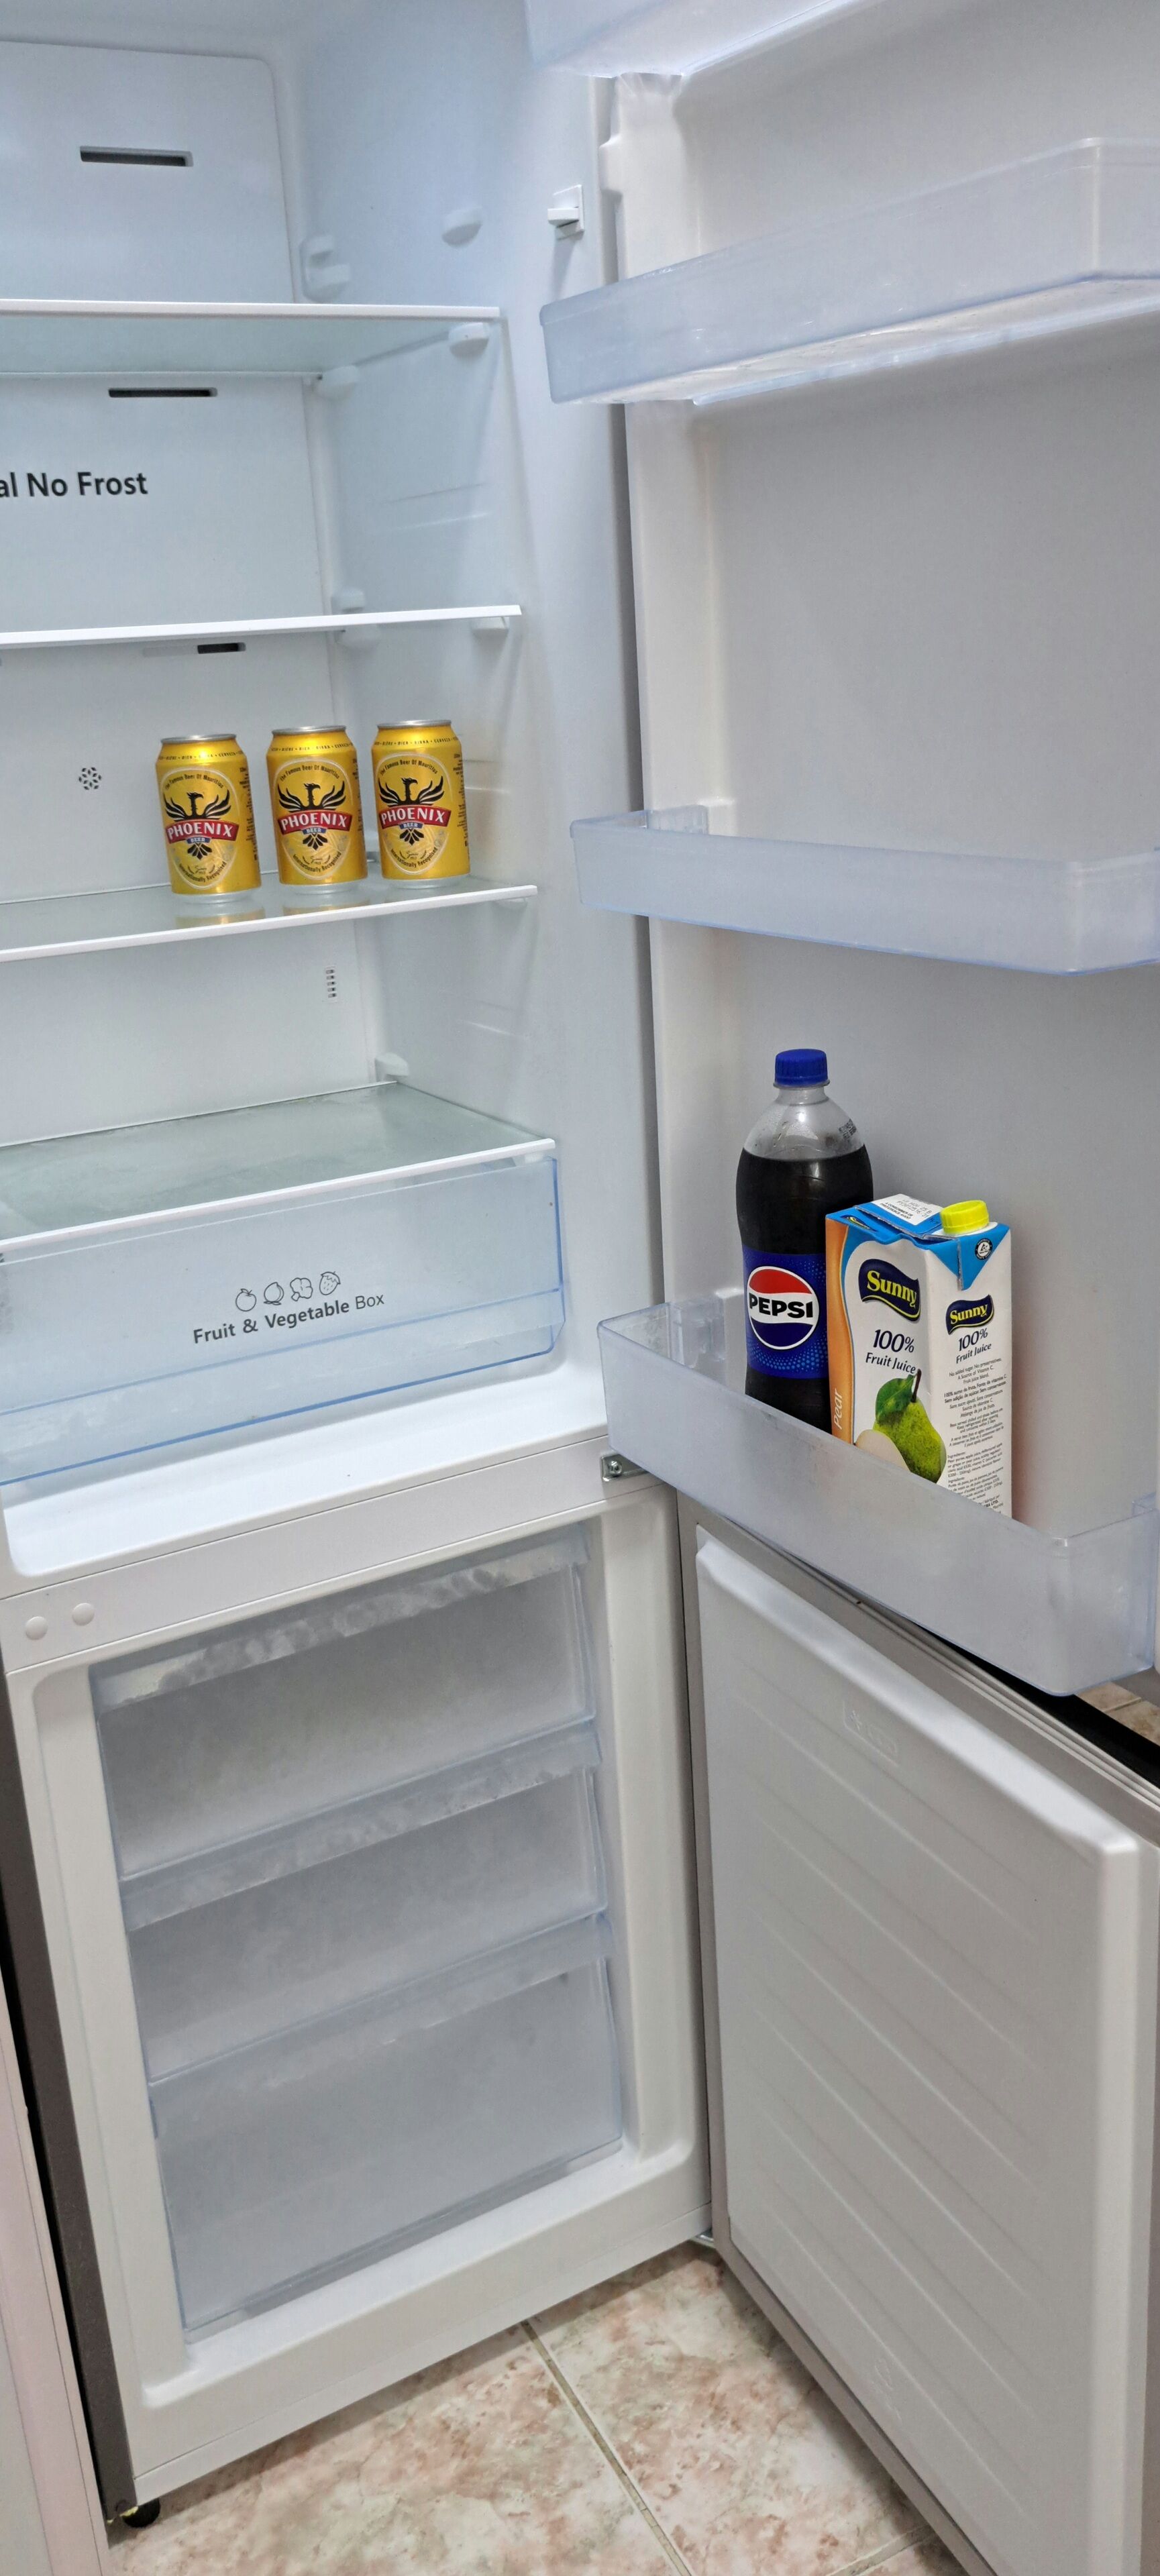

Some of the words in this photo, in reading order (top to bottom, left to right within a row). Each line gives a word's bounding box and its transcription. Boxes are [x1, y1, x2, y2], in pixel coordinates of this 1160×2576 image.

[27, 472, 68, 497] No
[77, 472, 148, 496] Frost
[280, 812, 347, 830] PHOENIX
[381, 808, 445, 825] PHOENIX
[168, 822, 233, 839] PHOENIX
[867, 1270, 917, 1308] Sunny
[749, 1292, 813, 1319] PEPSI
[950, 1304, 988, 1325] Sunny
[193, 1323, 235, 1344] Fruit
[242, 1318, 258, 1334] &
[265, 1299, 350, 1329] Vegetable
[355, 1294, 385, 1309] Box
[873, 1329, 914, 1353] 100%
[959, 1328, 988, 1352] 100%
[865, 1352, 892, 1367] Fruit
[892, 1357, 916, 1375] Juice
[956, 1350, 973, 1364] Fruit
[974, 1343, 992, 1356] Juice
[834, 1388, 843, 1430] Pear
